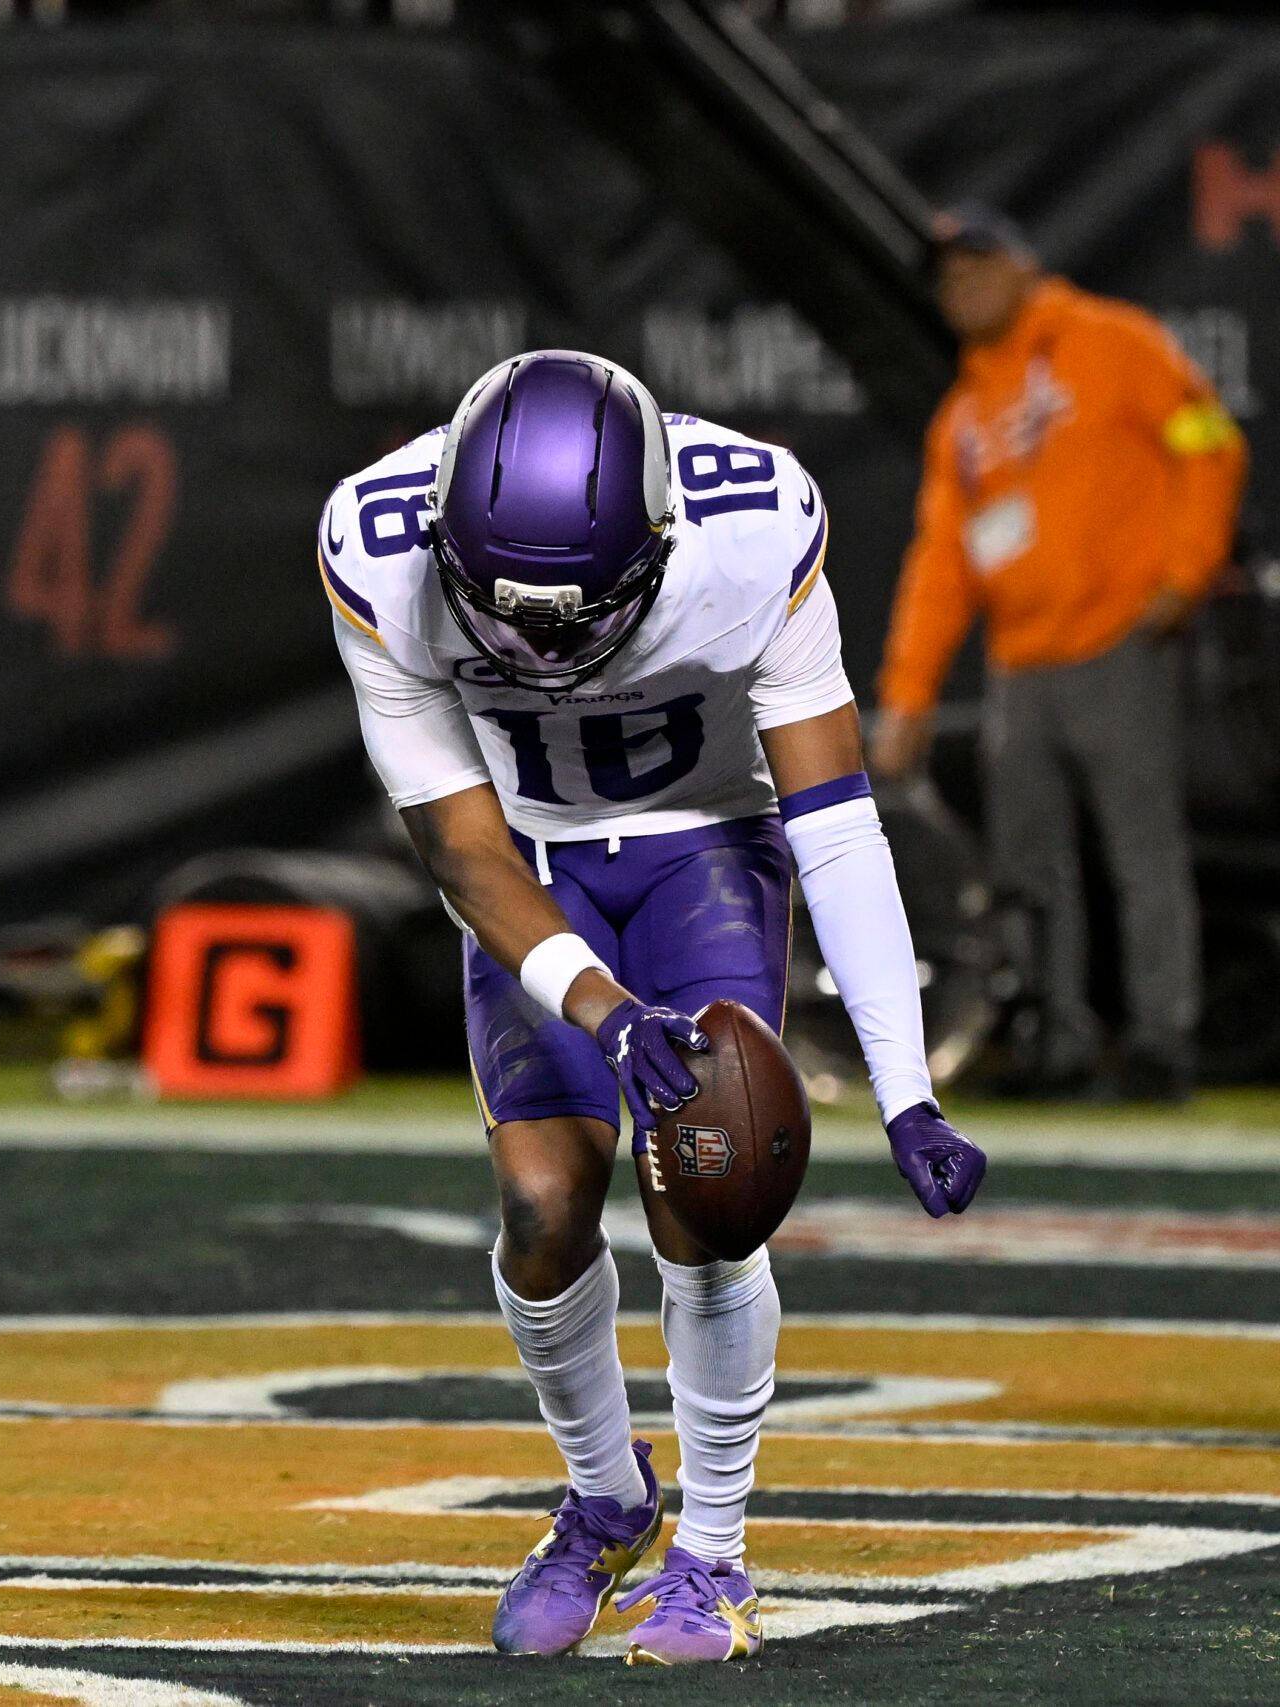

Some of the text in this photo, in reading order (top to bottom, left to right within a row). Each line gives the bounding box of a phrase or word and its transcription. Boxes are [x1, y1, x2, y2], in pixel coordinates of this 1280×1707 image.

[355, 463, 439, 558] 18
[677, 443, 779, 528] 18
[6, 425, 177, 656] 42
[196, 941, 298, 1067] G
[697, 1133, 726, 1172] NFL
